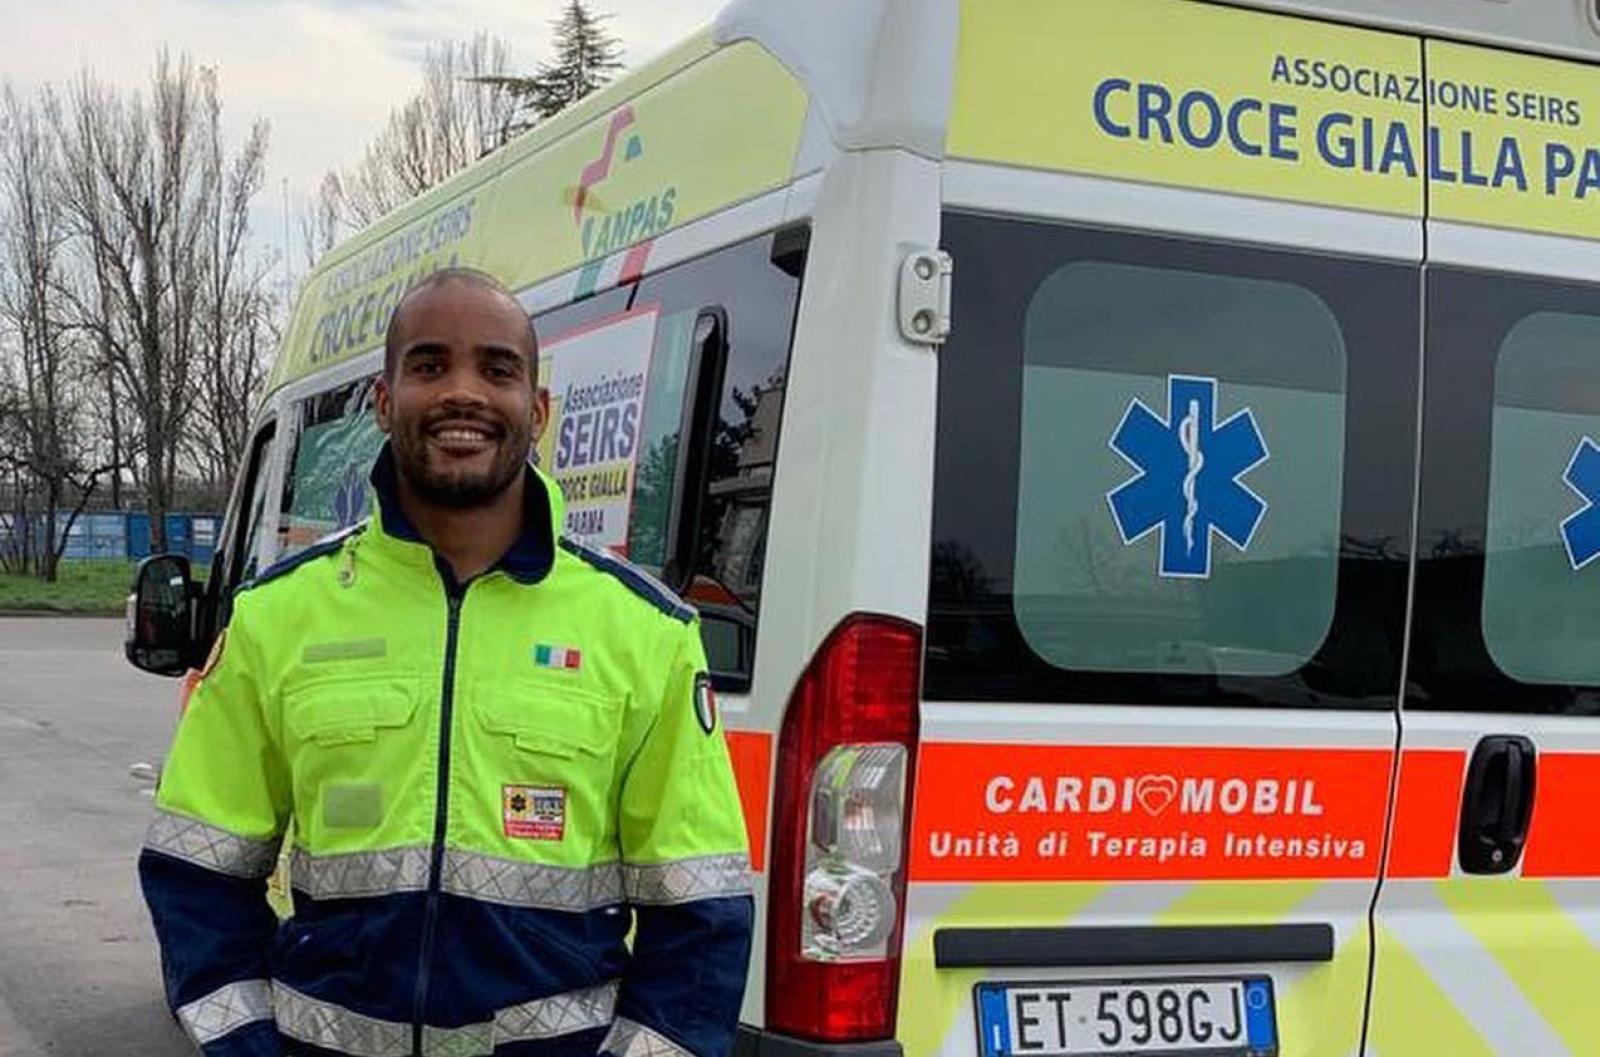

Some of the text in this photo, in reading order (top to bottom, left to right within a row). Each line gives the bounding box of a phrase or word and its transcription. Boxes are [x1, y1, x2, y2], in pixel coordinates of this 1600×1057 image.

[1270, 55, 1581, 126] ASSOCIAZIONE SEIRS
[1092, 78, 1300, 162] CROCE
[1315, 112, 1528, 193] GIALLA
[562, 370, 645, 416] Associazione
[556, 402, 639, 469] SEIRS
[929, 831, 1367, 864] Unità di Terapia Intensiva
